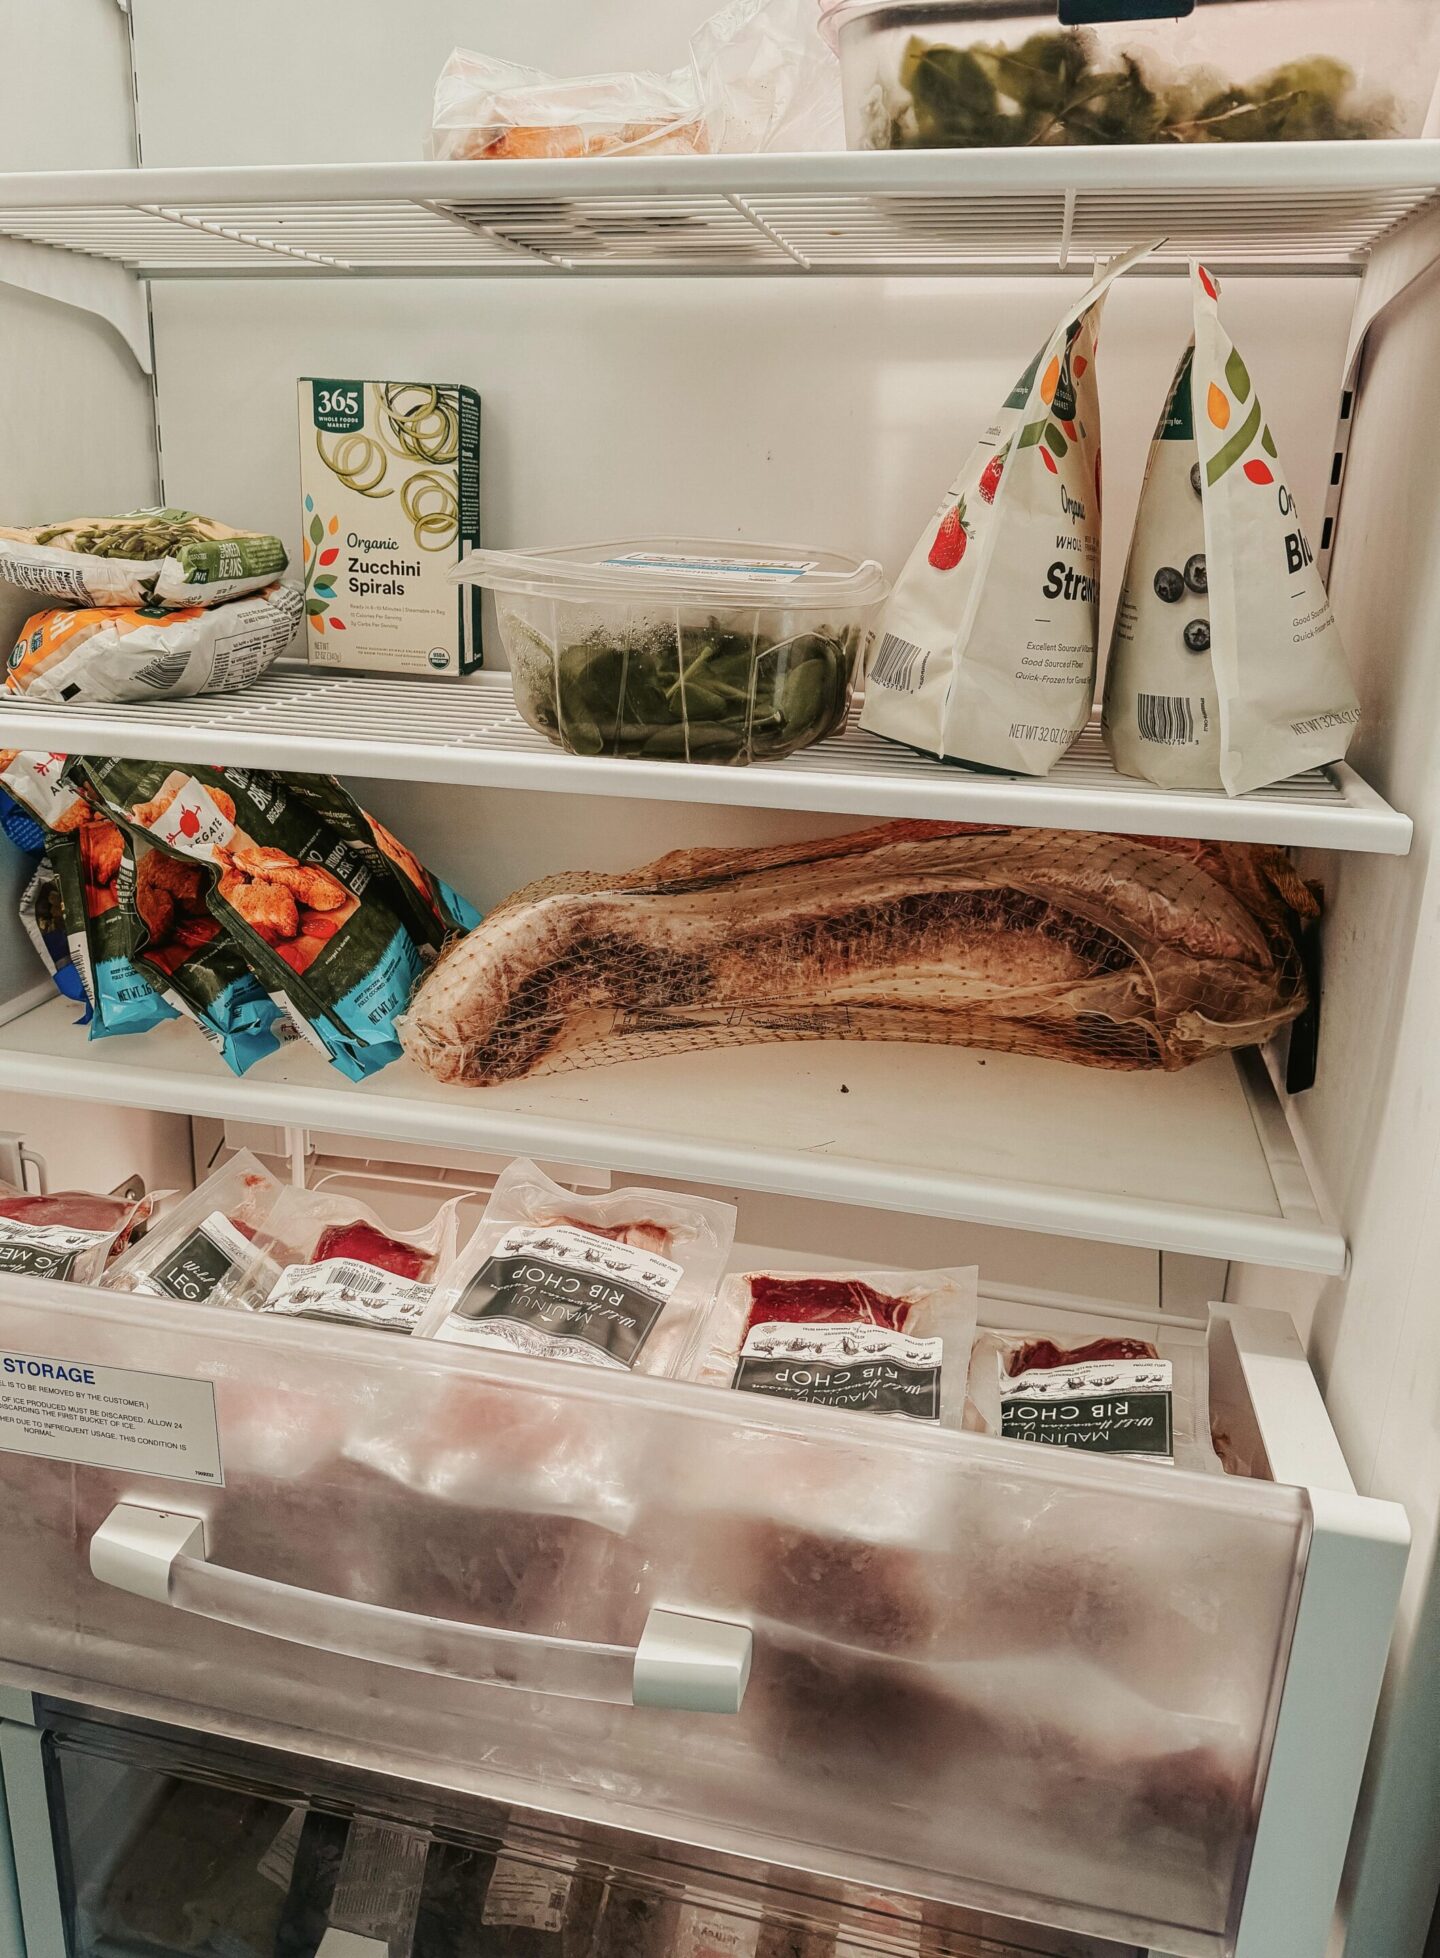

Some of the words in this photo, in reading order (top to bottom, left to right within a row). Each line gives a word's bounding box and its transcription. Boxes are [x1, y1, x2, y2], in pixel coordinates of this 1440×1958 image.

[318, 389, 358, 415] 365
[319, 416, 338, 424] WHOLE
[347, 532, 399, 553] Organic
[219, 558, 243, 578] BEANS
[348, 557, 421, 577] Zucchini
[349, 577, 405, 597] Spirals
[1292, 612, 1311, 627] Good
[1027, 642, 1056, 651] Excellent
[1022, 657, 1043, 667] Good
[1044, 659, 1066, 668] Source
[1016, 671, 1065, 684] Quick-Frozen
[1009, 723, 1026, 739] NET
[1025, 724, 1039, 740] WT
[1038, 726, 1050, 742] 32
[1050, 728, 1060, 743] OZ
[1290, 721, 1309, 735] NET
[1306, 718, 1323, 732] WT
[1319, 714, 1336, 728] 32
[189, 817, 223, 848] EGATE
[117, 988, 131, 1002] NET
[358, 995, 369, 1008] FULLY
[368, 982, 386, 997] COOKED
[364, 977, 380, 994] FROZEN
[368, 1004, 381, 1025] NET
[182, 1260, 216, 1283] Wild
[512, 1265, 580, 1293] CHOP
[167, 1267, 200, 1299] LEG
[589, 1284, 625, 1306] RIB
[511, 1293, 593, 1324] MAUINUI
[599, 1309, 637, 1329] Wild
[4, 1358, 95, 1385] STORAGE
[776, 1369, 851, 1386] CHOP
[863, 1367, 898, 1380] RIB
[39, 1386, 74, 1397] REMOVED
[87, 1393, 101, 1401] THE
[103, 1396, 149, 1410] CUSTOMER.)
[13, 1397, 25, 1405] ICE
[27, 1399, 66, 1411] PRODUCED
[68, 1406, 88, 1414] MUST
[101, 1411, 145, 1424] DISCARDED.
[147, 1418, 172, 1428] ALLOW
[42, 1409, 56, 1417] THE
[58, 1411, 78, 1420] FIRST
[80, 1415, 107, 1426] BUCKET
[122, 1422, 136, 1430] ICE.
[1002, 1406, 1079, 1420] CHOP
[1091, 1402, 1129, 1418] RIB
[24, 1427, 55, 1437] NORMAL.
[1041, 1419, 1113, 1430] Hawaiian
[1114, 1416, 1153, 1429] Wild
[17, 1417, 31, 1426] DUE
[44, 1422, 89, 1435] INFREQUENT
[91, 1430, 118, 1440] USAGE.
[119, 1435, 136, 1443] THIS
[137, 1438, 178, 1450] CONDITION
